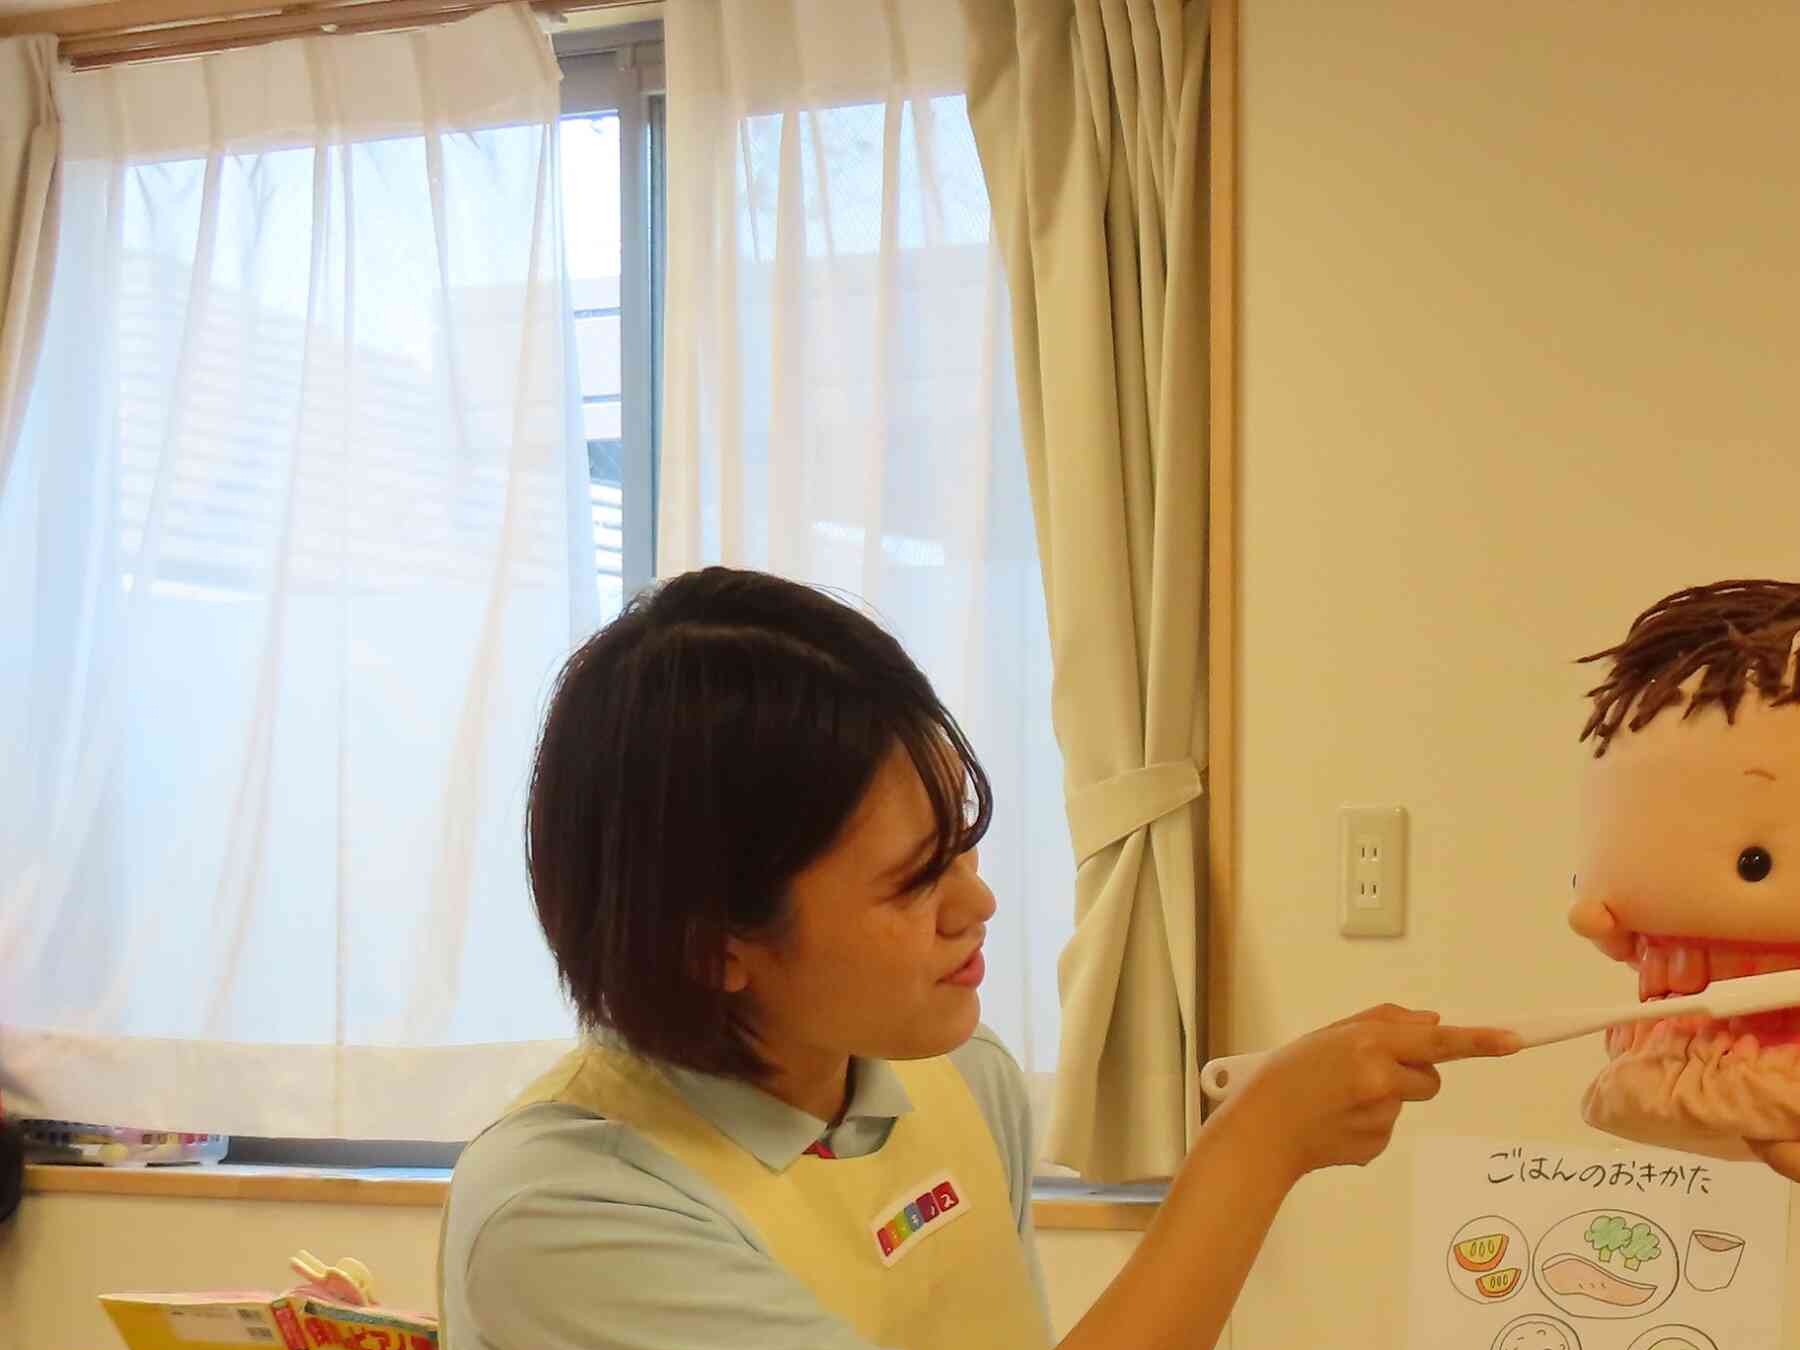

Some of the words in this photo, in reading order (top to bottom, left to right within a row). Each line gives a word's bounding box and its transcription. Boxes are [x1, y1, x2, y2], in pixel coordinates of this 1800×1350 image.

[1487, 1147, 1712, 1194] ごはんのおきかた
